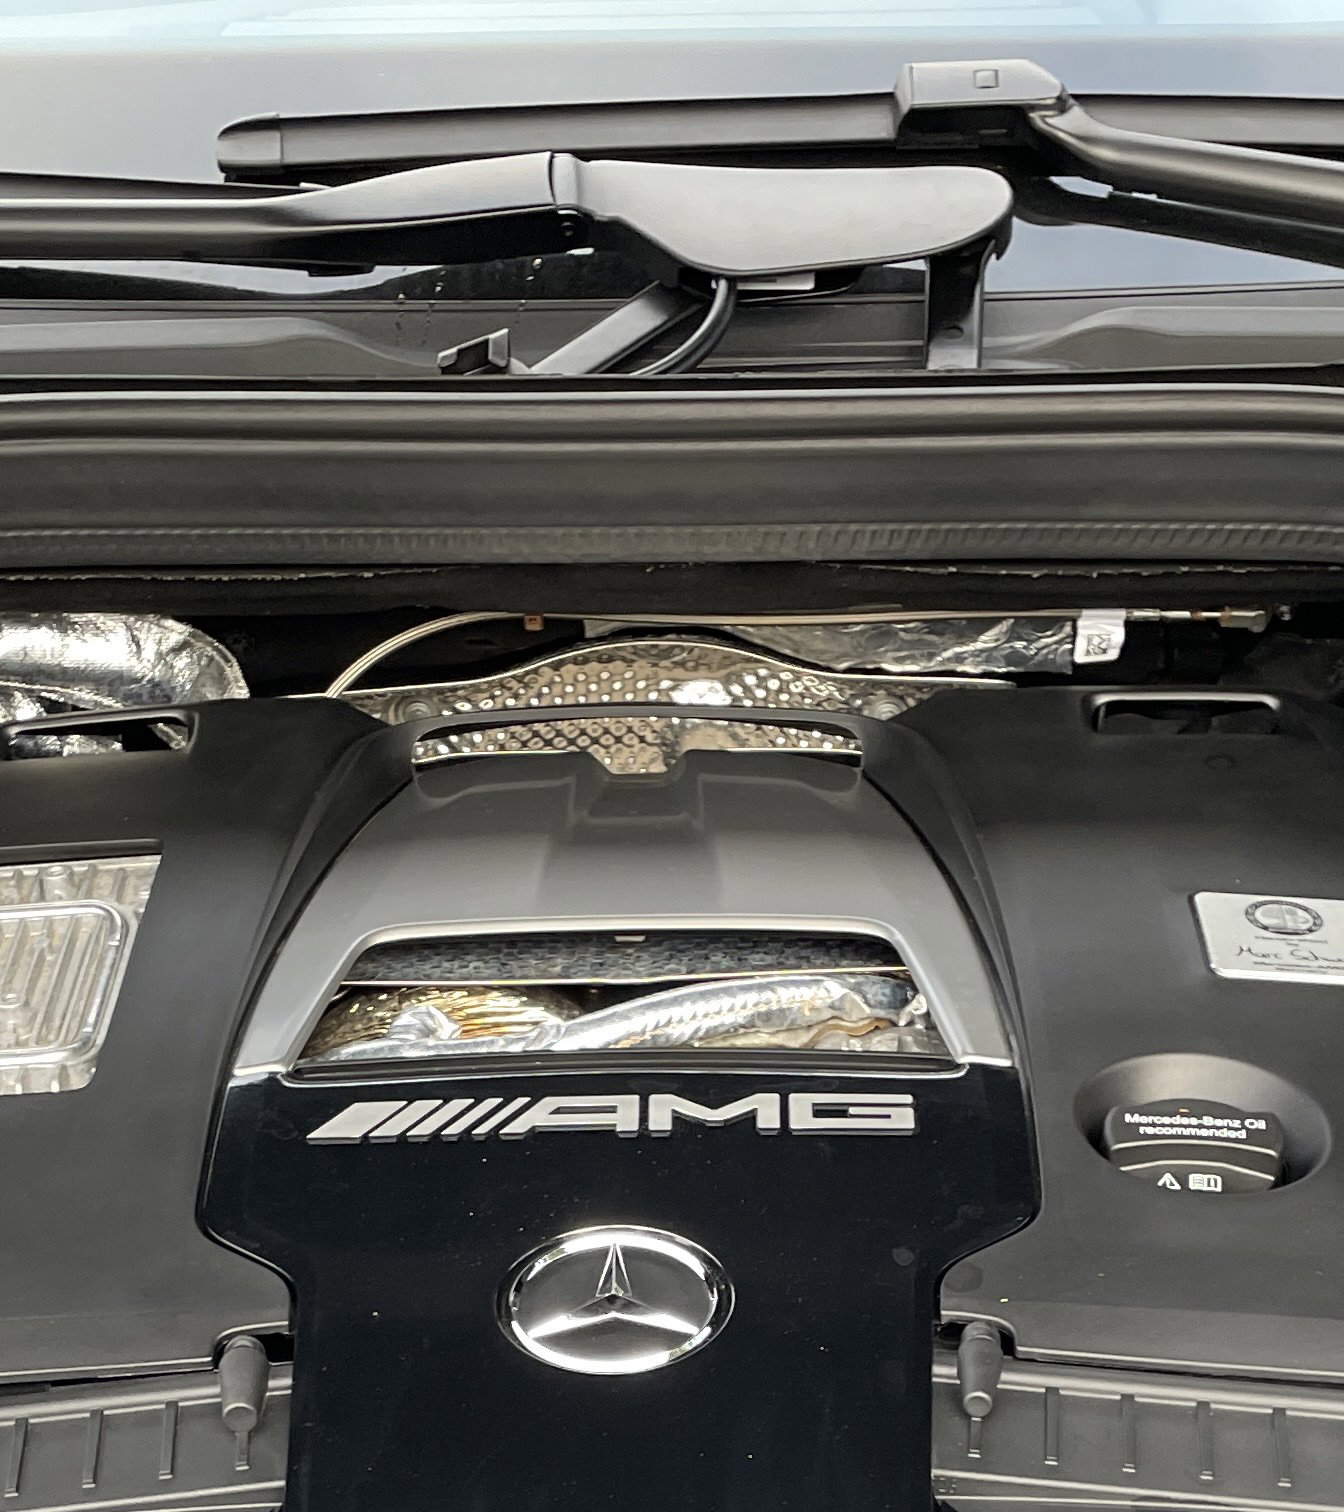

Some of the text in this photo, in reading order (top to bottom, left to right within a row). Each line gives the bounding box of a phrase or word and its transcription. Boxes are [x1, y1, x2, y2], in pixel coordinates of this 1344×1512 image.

[499, 1092, 914, 1139] AMG
[1124, 1112, 1267, 1130] Mercedes-Benz Oil
[1139, 1125, 1247, 1139] recommended
